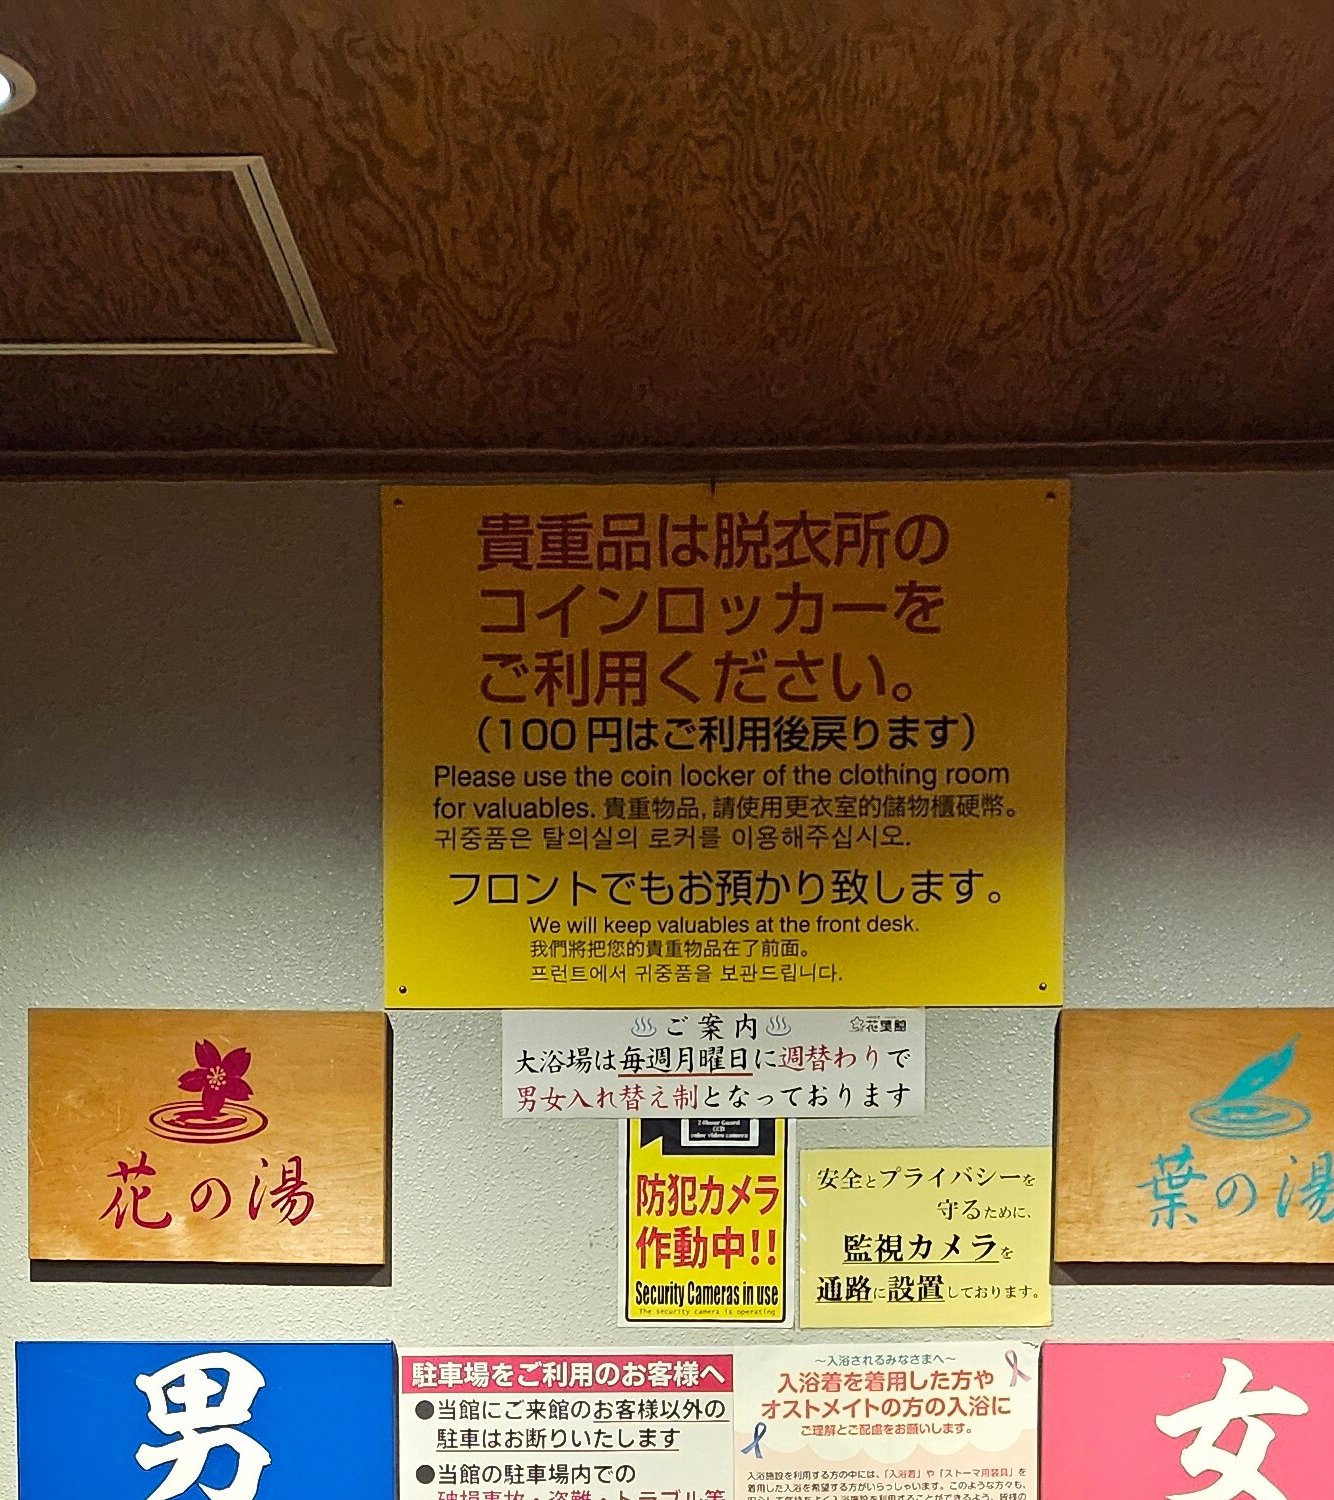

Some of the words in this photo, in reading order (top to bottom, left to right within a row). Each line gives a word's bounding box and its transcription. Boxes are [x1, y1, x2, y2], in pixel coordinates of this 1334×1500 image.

[477, 510, 949, 572] 貴重品は脱衣所の
[479, 581, 945, 638] コインロッカーを
[479, 649, 913, 706] ご利用ください。
[433, 765, 515, 789] Please
[523, 771, 567, 788] use
[575, 766, 612, 788] the
[621, 766, 671, 787] coin
[680, 765, 756, 787] locker
[763, 765, 787, 787] of
[793, 765, 832, 787] the
[839, 765, 937, 792] clothing
[946, 769, 1010, 785] room
[433, 797, 465, 820] for
[473, 797, 595, 820] valuables.
[435, 827, 532, 850] 귀중품은
[543, 826, 638, 850] 탈의실의
[649, 826, 722, 849] 로커를
[733, 824, 911, 850] 이용해주십시오.
[448, 868, 1001, 907] フロントでもお預かり致します。
[530, 916, 560, 934] We
[567, 916, 597, 934] will
[605, 916, 651, 937] keep
[658, 916, 750, 934] valuables
[756, 917, 774, 932] at
[780, 916, 810, 932] the
[816, 916, 860, 932] front
[867, 915, 919, 932] desk.
[530, 965, 626, 983] 프런트에서
[635, 965, 712, 983] 귀중품을
[720, 963, 843, 983] 보관드립니다.
[516, 1046, 912, 1074] 大浴場は毎週月曜日に週替わりで
[516, 1083, 912, 1112] 男女入れ替え制となっております
[98, 1150, 316, 1231] 花の湯
[818, 1166, 1035, 1190] 安全とプライバシーを
[636, 1173, 780, 1217] 防犯カメラ
[938, 1199, 1032, 1220] 守るために、
[636, 1226, 777, 1271] 作動中!!
[844, 1233, 1013, 1262] 監視カメラを
[636, 1281, 684, 1307] Security
[688, 1281, 739, 1305] Cameras
[743, 1281, 753, 1305] in
[757, 1285, 778, 1305] use
[817, 1275, 1039, 1302] 通路に設置しております。
[412, 1360, 726, 1388] 駐車場をご利用のお客様へ
[778, 1369, 994, 1393] 入浴着を着用した方や
[438, 1399, 726, 1421] 当館にご来館のお客様以外の
[762, 1396, 1010, 1419] オストメイトの方の入浴に
[436, 1428, 681, 1449] 駐車はお断りいたします
[800, 1423, 972, 1436] ご理解とご配慮をお願いします。
[438, 1464, 636, 1485] 当館の駐車場内での
